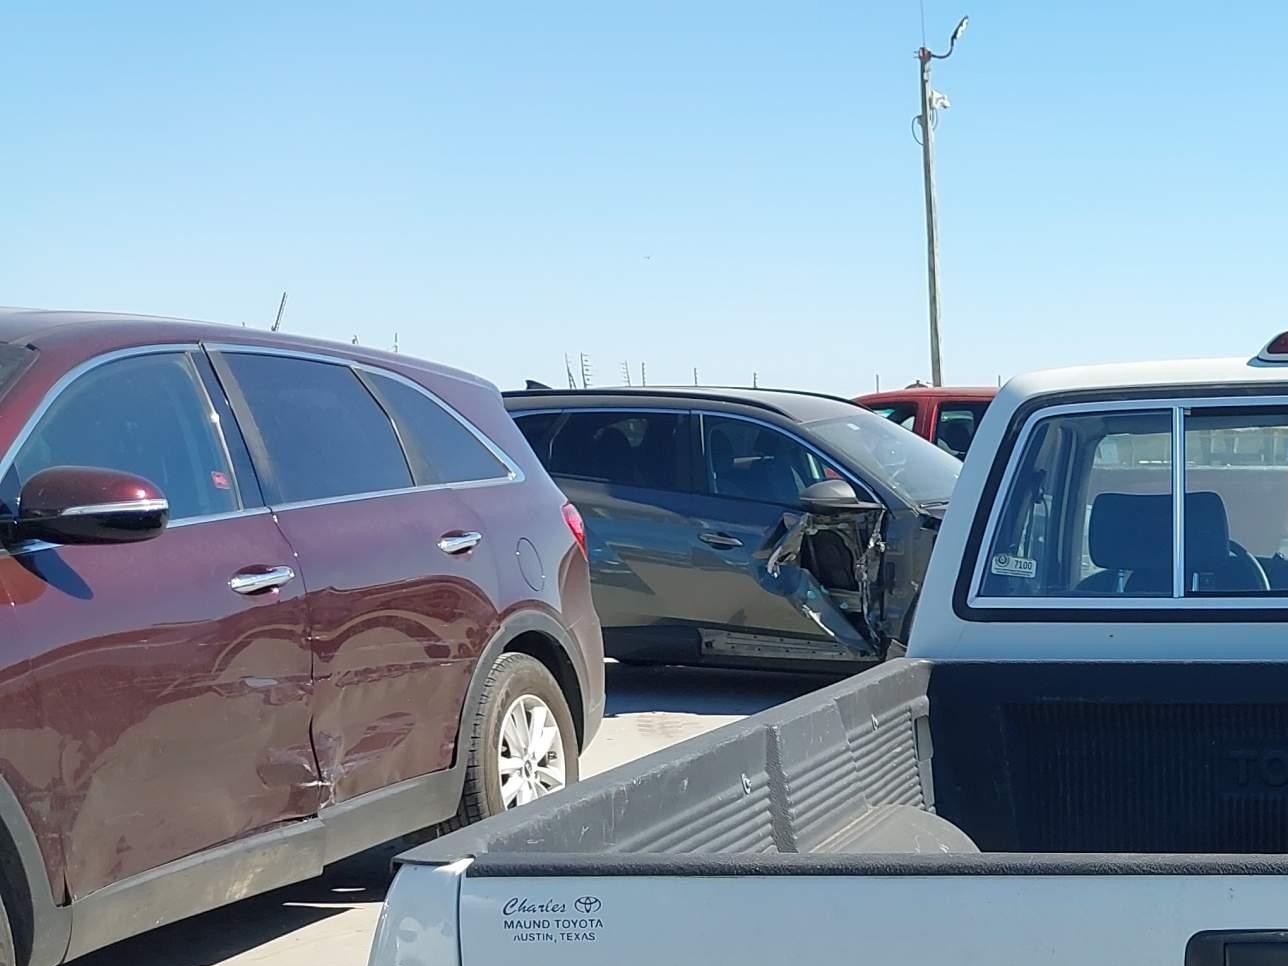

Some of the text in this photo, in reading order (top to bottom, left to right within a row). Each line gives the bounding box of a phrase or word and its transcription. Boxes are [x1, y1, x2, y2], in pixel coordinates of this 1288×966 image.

[1014, 560, 1033, 571] 7100
[502, 897, 567, 916] Charles
[503, 918, 604, 930] MAUND TOYOTA
[559, 931, 596, 941] TEXAS
